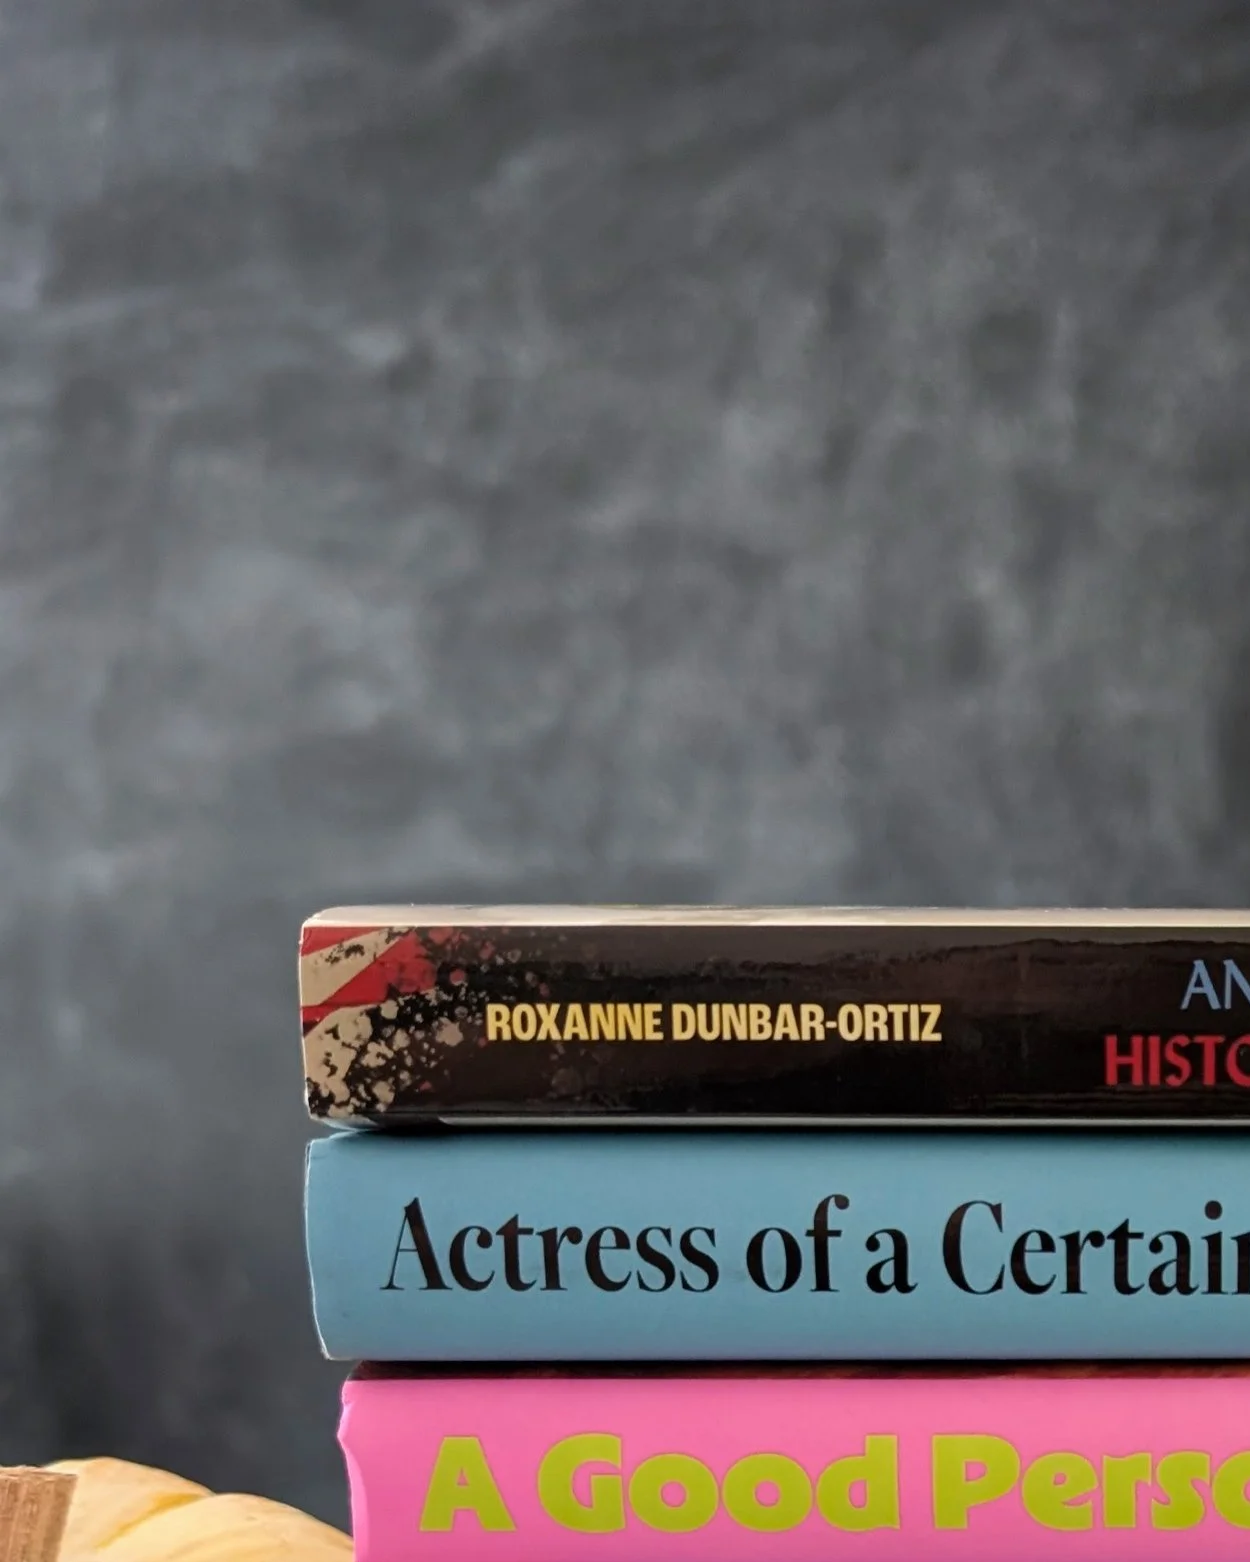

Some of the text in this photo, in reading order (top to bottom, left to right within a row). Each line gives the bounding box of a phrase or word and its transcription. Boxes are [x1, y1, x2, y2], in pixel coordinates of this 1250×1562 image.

[485, 1002, 942, 1043] ROXANNE DUNBAR-ORTIZ
[379, 1197, 720, 1293] Actress
[745, 1194, 850, 1294] of
[865, 1228, 917, 1294] a
[419, 1436, 517, 1532] A
[537, 1432, 900, 1534] Good
